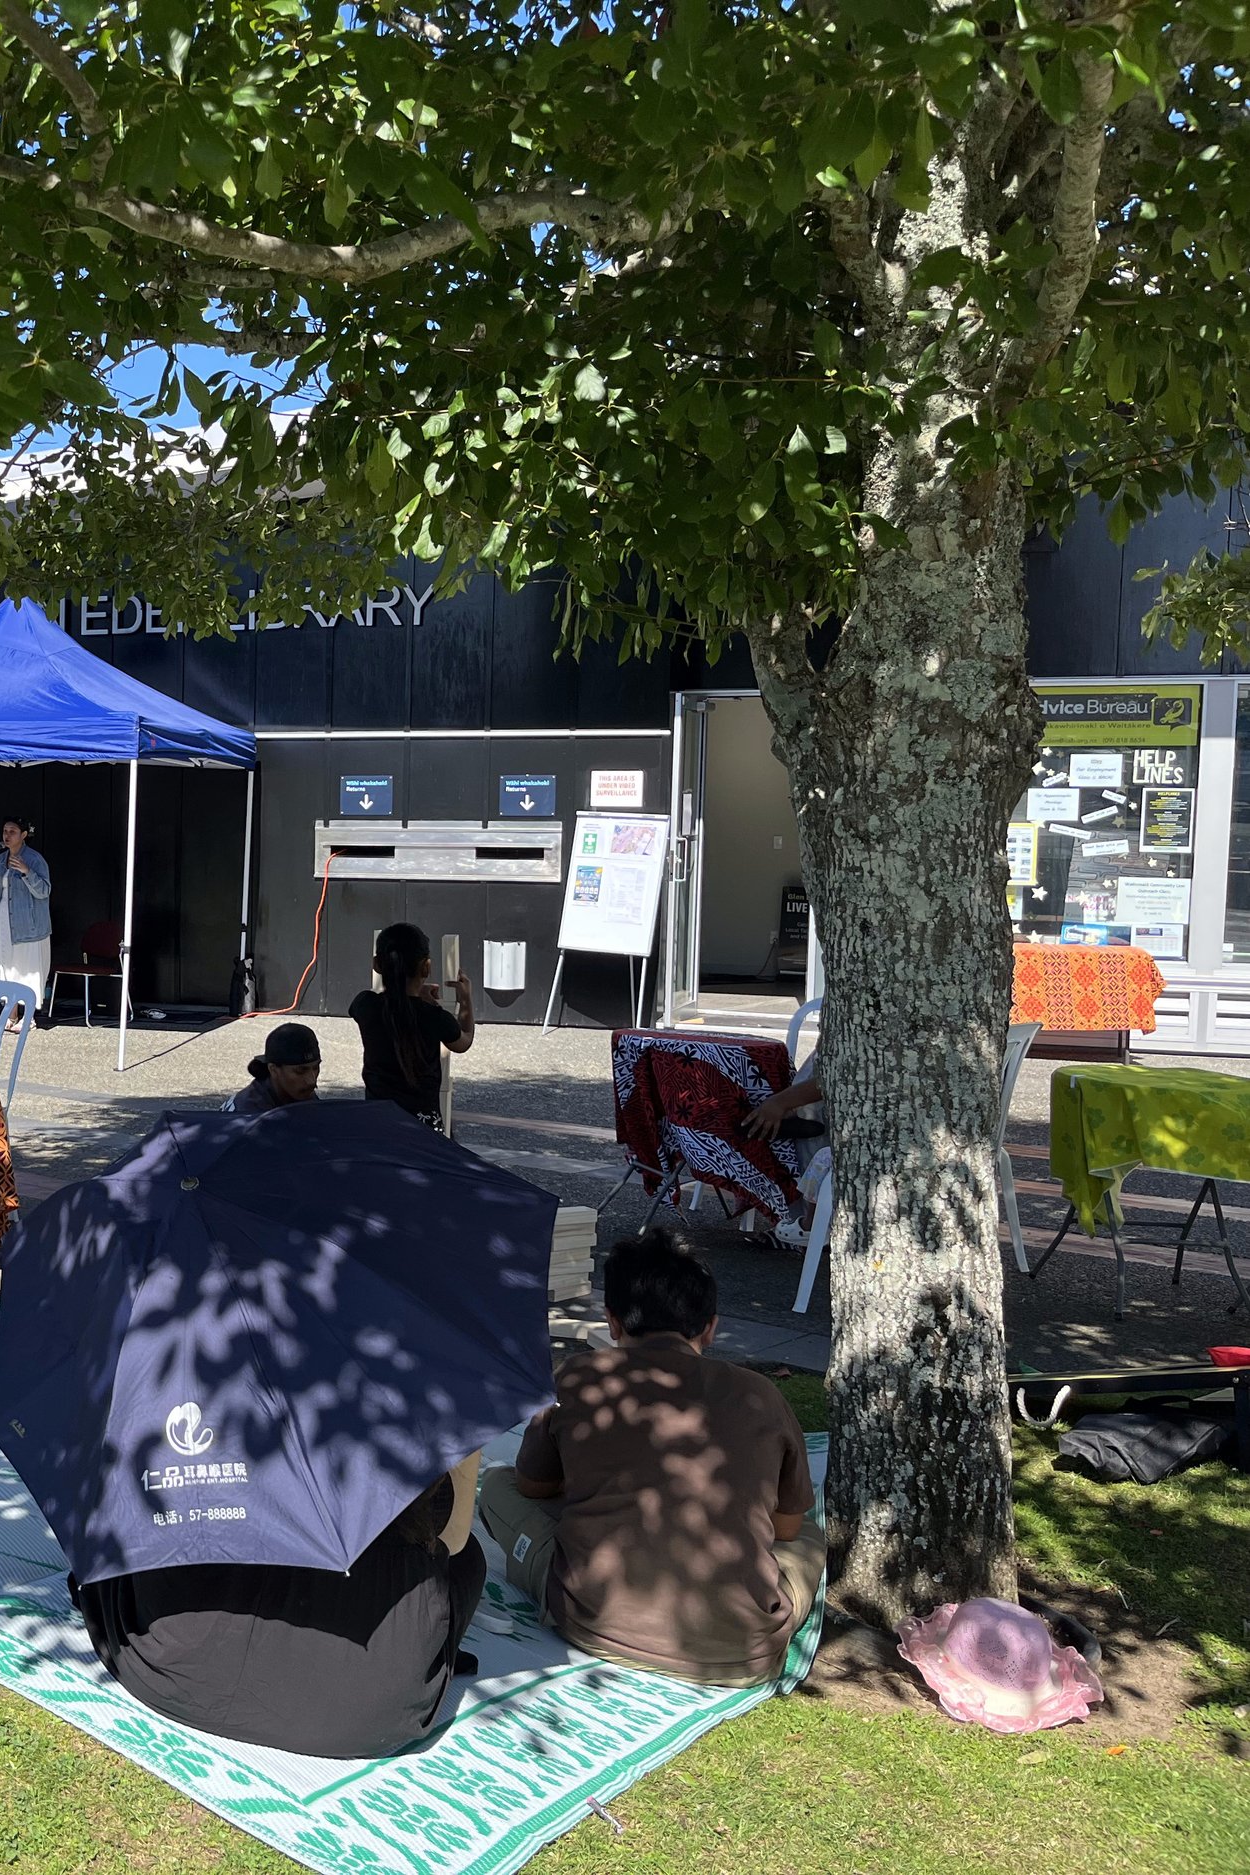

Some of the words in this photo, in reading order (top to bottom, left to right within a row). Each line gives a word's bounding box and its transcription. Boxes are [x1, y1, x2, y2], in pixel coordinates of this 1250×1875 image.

[80, 595, 184, 636] EDE
[1039, 699, 1085, 715] dvice
[1086, 699, 1149, 715] Bureau
[1133, 749, 1177, 768] HELP
[1132, 766, 1184, 784] LINES
[595, 789, 638, 797] SURVEILLANCE
[786, 901, 808, 913] LIVE
[141, 1466, 184, 1492] 仁品
[189, 1507, 247, 1521] 57-888888
